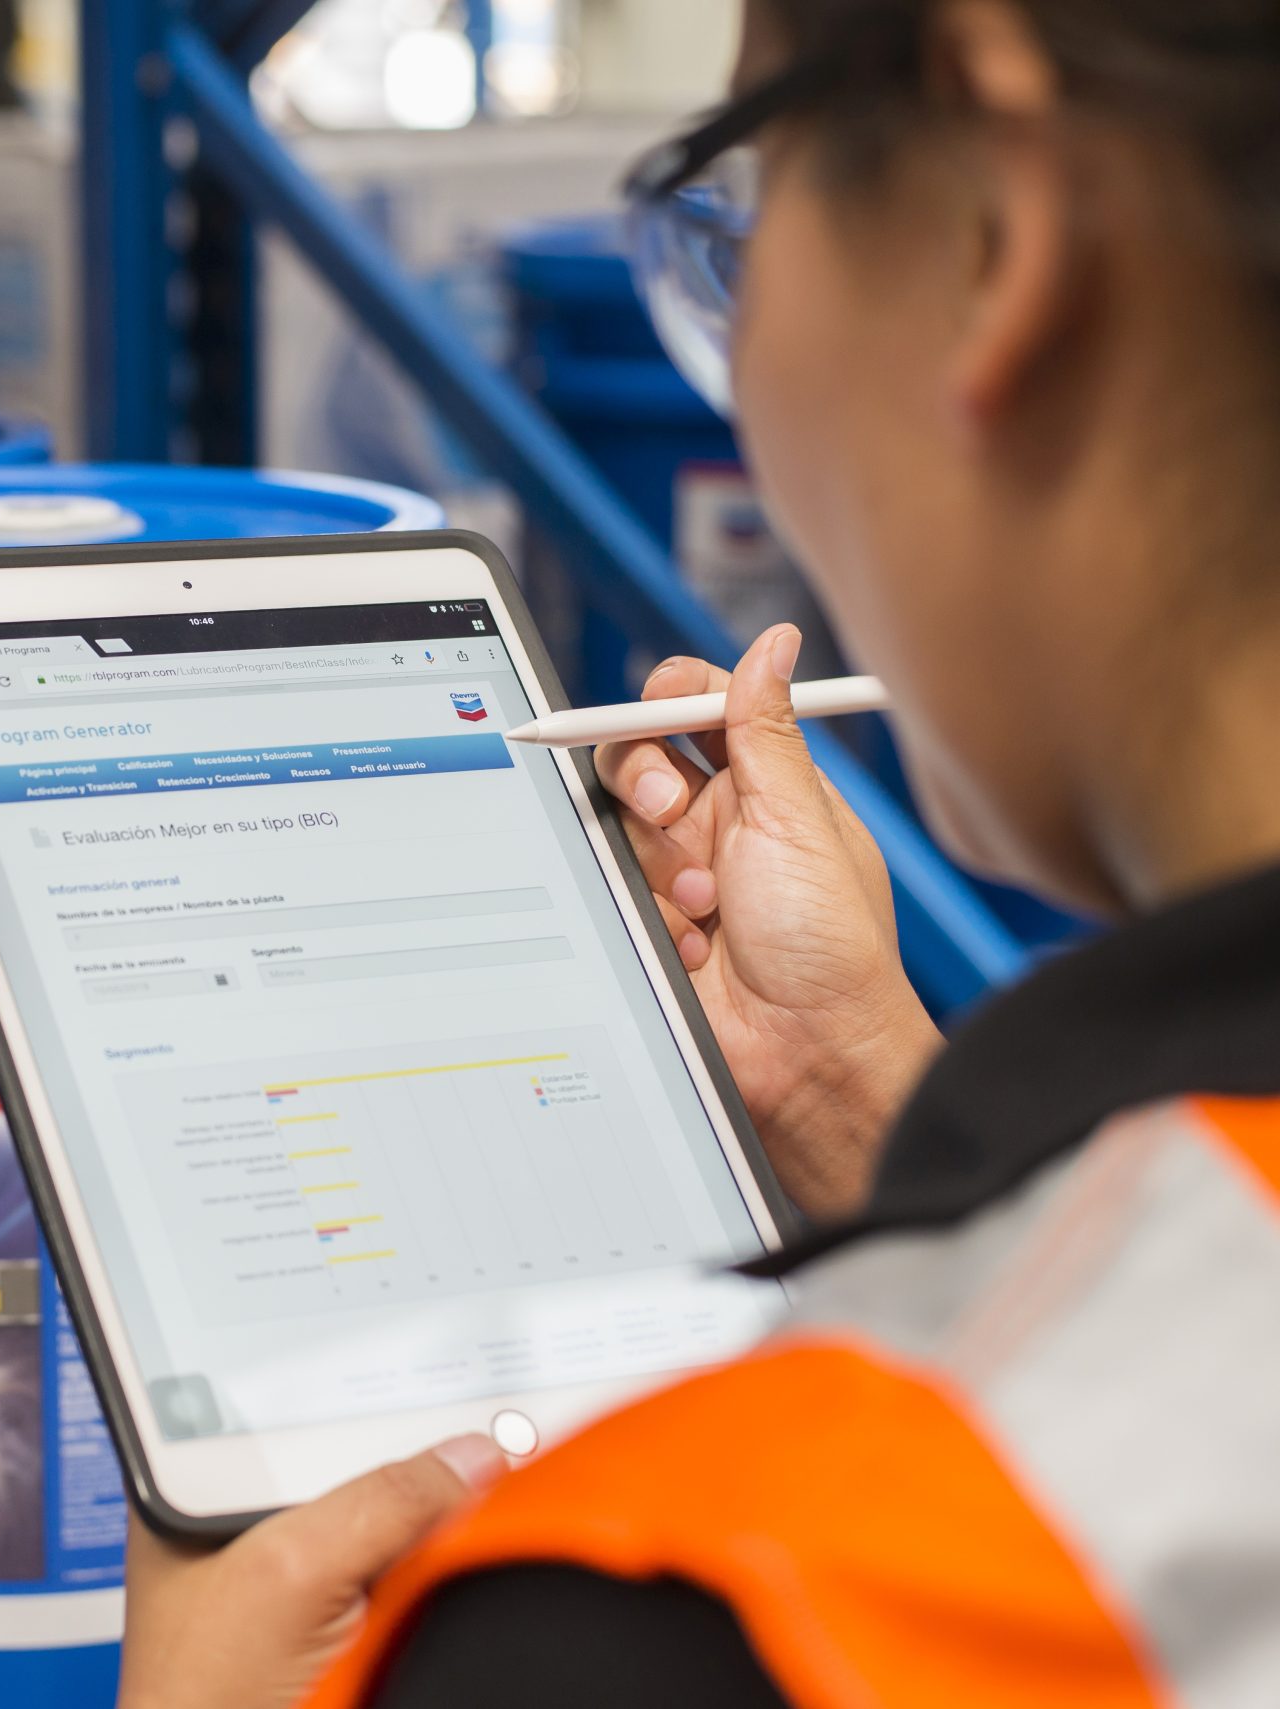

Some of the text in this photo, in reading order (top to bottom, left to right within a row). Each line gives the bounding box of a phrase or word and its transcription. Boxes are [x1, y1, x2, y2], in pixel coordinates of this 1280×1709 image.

[189, 617, 214, 626] 10:46
[5, 645, 51, 657] Programa
[449, 691, 480, 700] Chevron
[64, 721, 153, 740] Generator
[332, 745, 392, 756] Presentacion
[194, 754, 254, 766] Necesidades
[261, 750, 313, 762] Soluciones
[55, 764, 97, 778] principal
[291, 767, 331, 777] Recusos
[350, 761, 426, 774] Perfil del usuario
[158, 776, 205, 788] Retencion
[215, 770, 270, 783] Crecimiento
[87, 780, 137, 793] Transicion
[62, 811, 339, 846] Evaluación Mejor en su tipo (BIC)
[47, 875, 181, 896] Información general
[56, 911, 99, 921] Nombre
[102, 908, 114, 917] de
[117, 907, 126, 916] la
[129, 903, 174, 916] empresa
[183, 898, 223, 911] Nombre
[226, 896, 239, 906] de
[241, 896, 251, 905] la
[253, 893, 285, 905] planta
[251, 944, 304, 957] Segmento
[111, 961, 122, 970] de
[104, 1043, 175, 1061] Segmento
